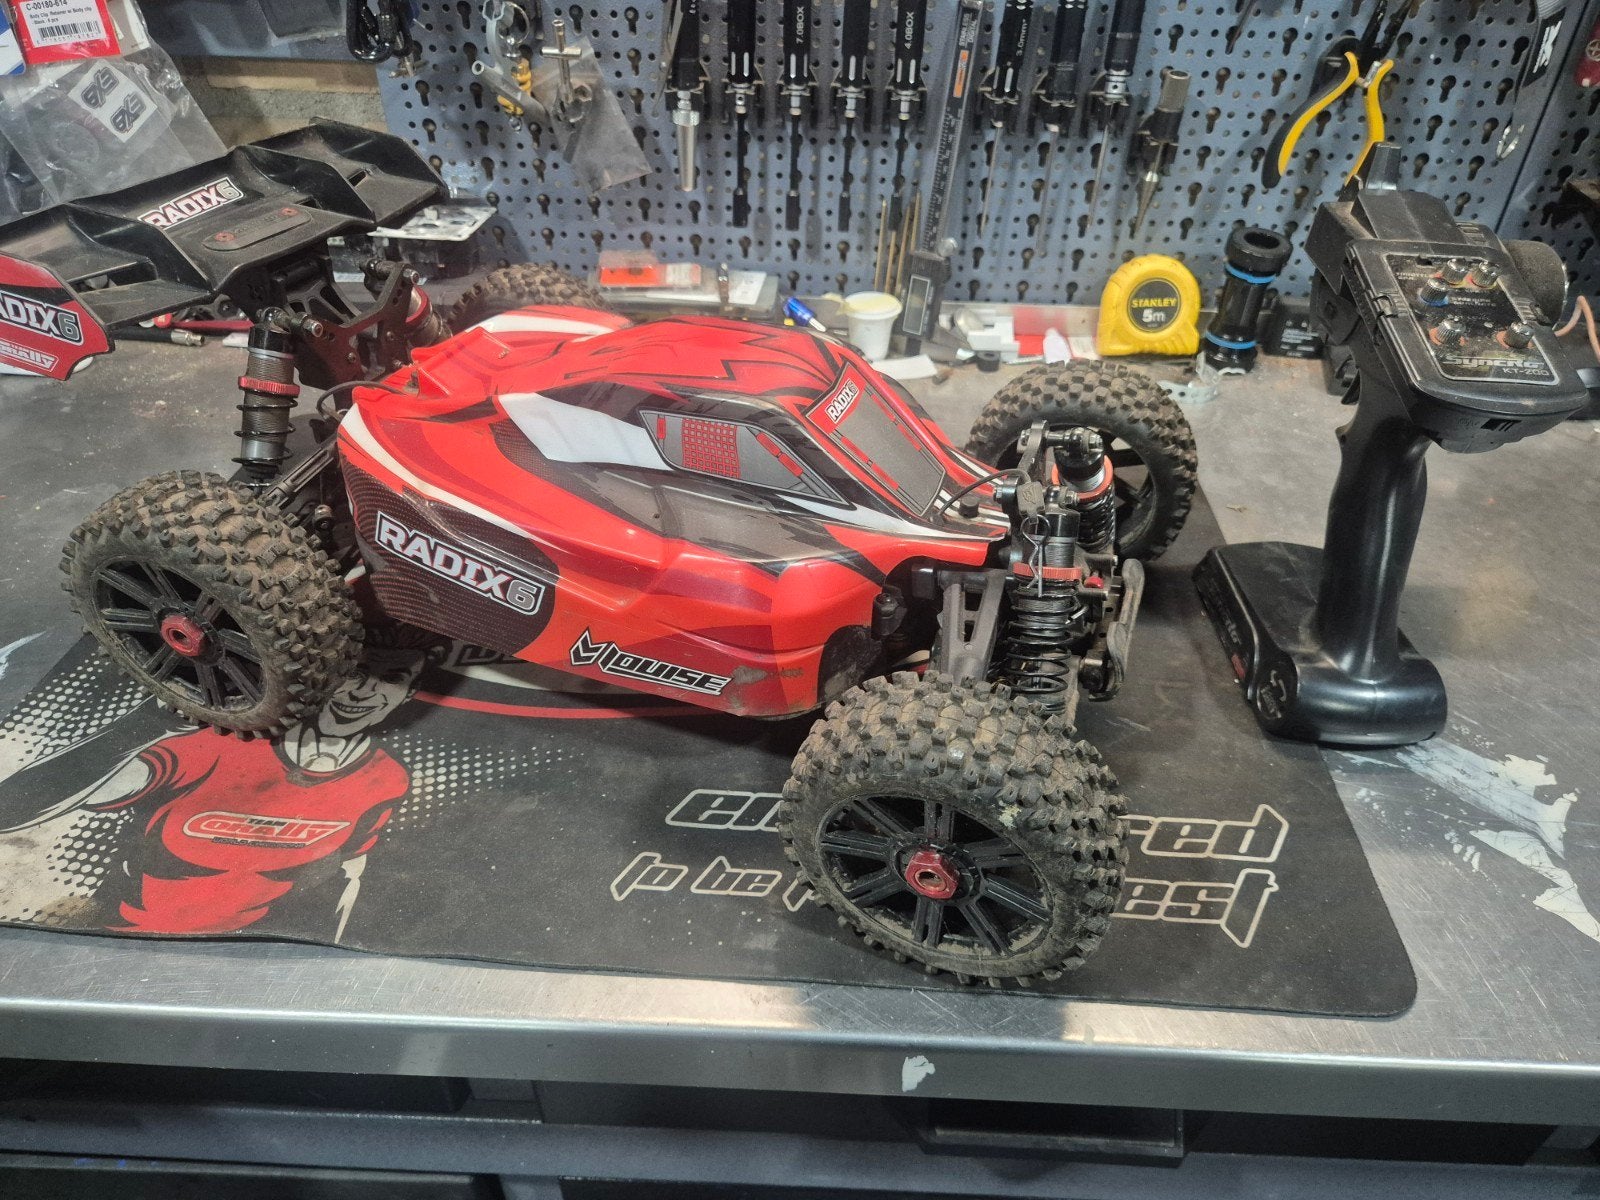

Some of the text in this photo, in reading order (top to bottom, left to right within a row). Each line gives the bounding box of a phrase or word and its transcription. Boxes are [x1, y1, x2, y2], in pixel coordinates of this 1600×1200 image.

[796, 6, 805, 44] 7.0BOX
[904, 11, 915, 49] 4.0BOX
[139, 178, 243, 231] RADIX6
[1131, 297, 1177, 309] STANLEY
[1141, 308, 1166, 324] 5m
[1503, 367, 1549, 376] KT-200
[825, 379, 859, 423] RADIX6
[376, 513, 543, 614] RADIX6
[690, 855, 783, 897] be
